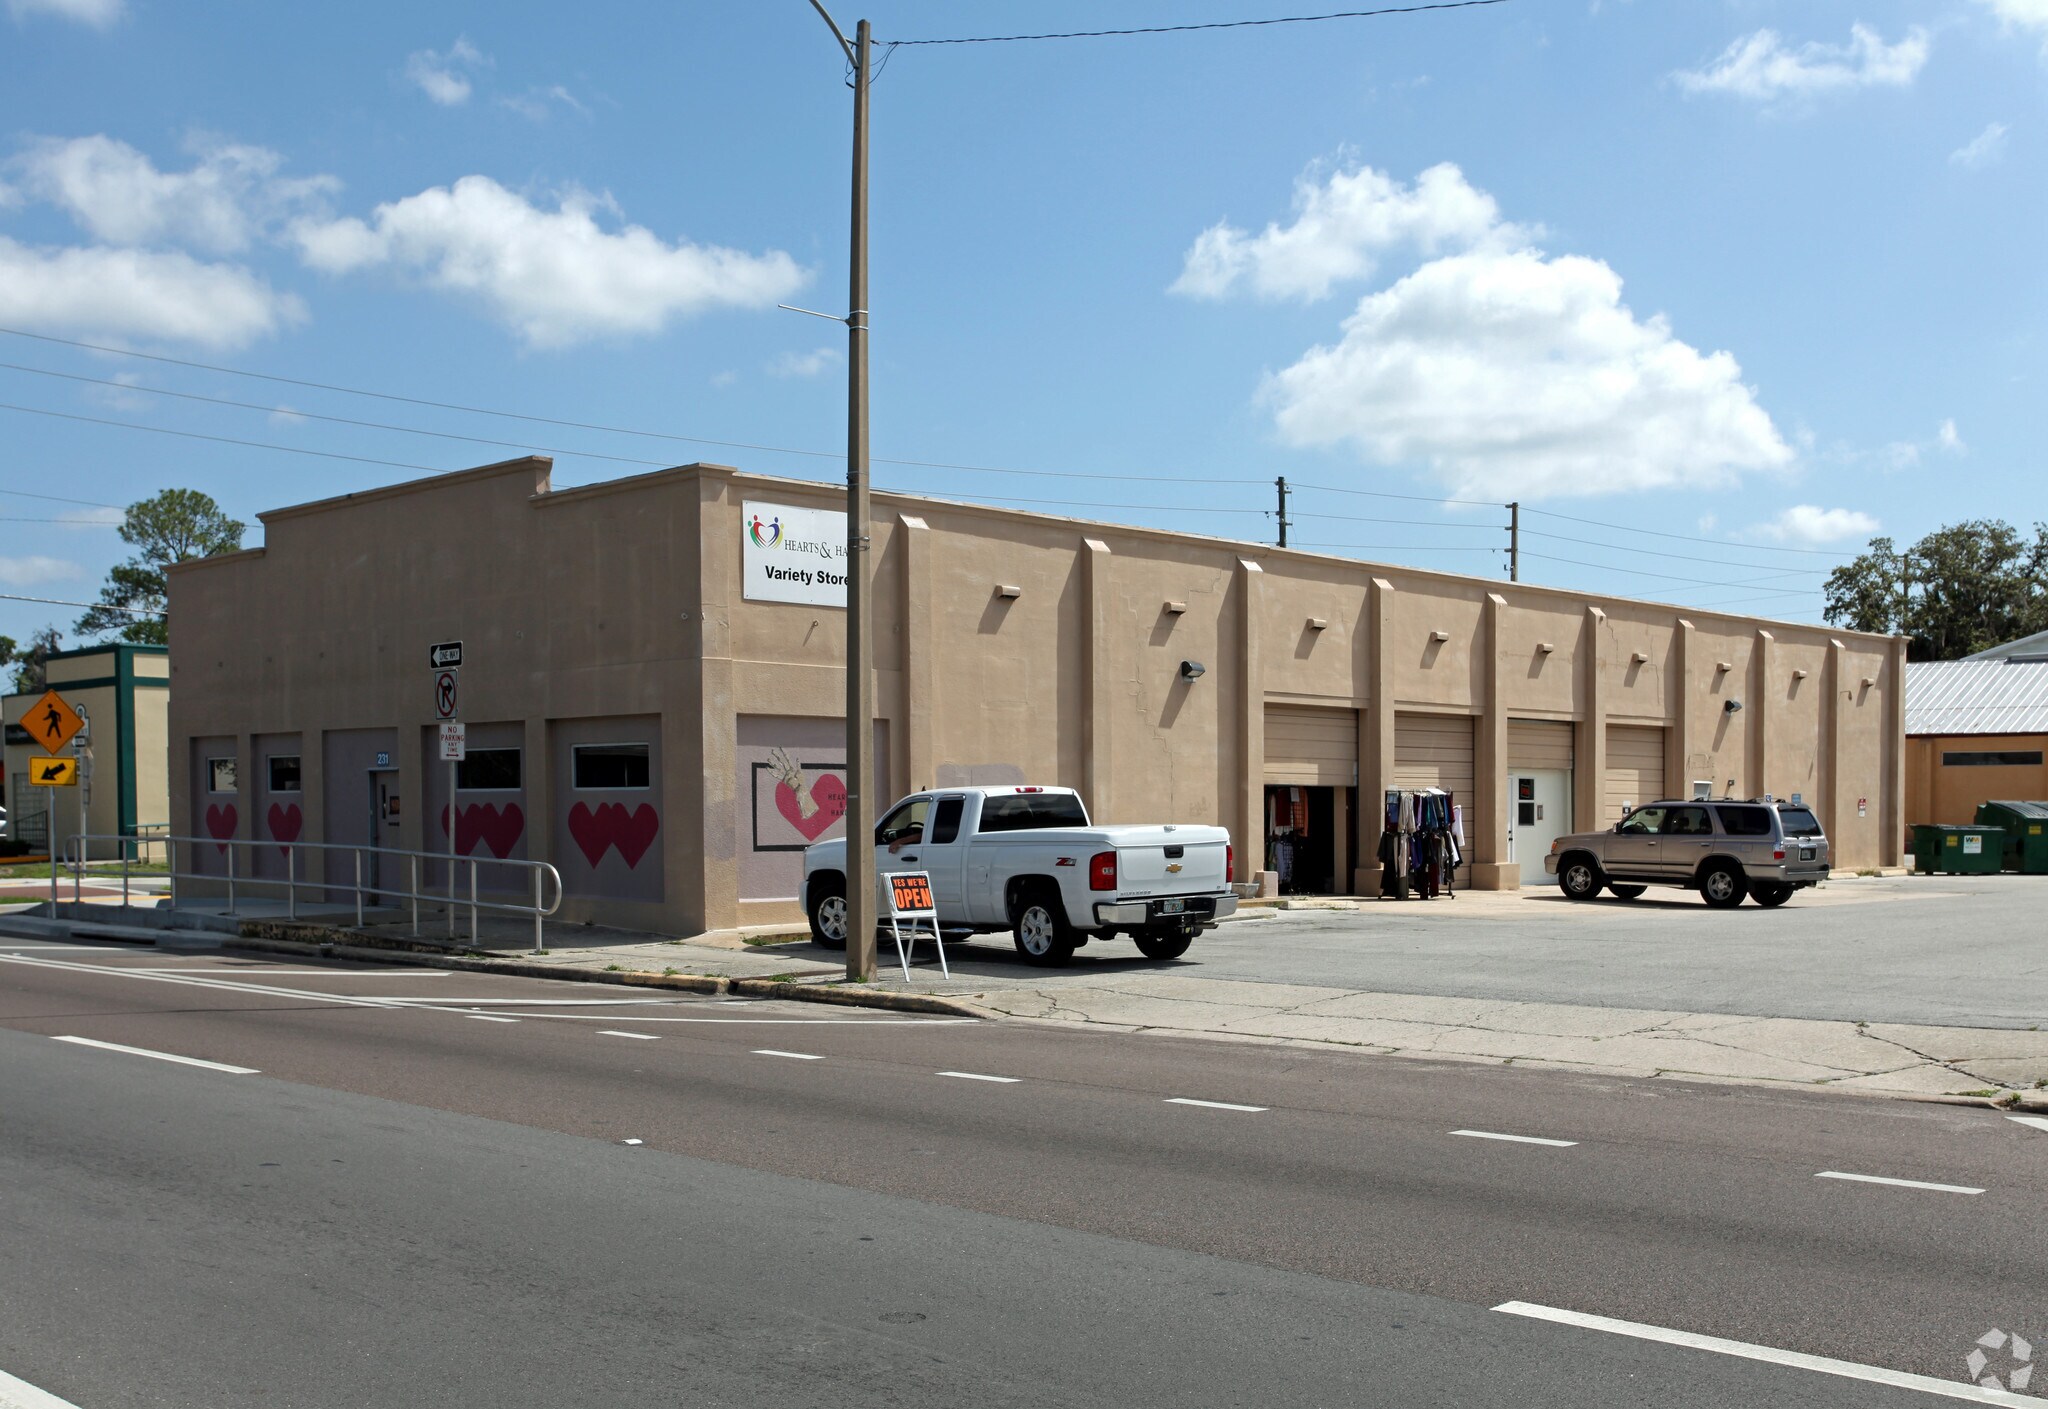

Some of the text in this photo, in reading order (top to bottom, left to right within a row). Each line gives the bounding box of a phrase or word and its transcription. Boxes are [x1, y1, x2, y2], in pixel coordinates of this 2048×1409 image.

[784, 539, 848, 559] HEARTS & HA
[765, 565, 813, 586] Variety
[439, 649, 459, 661] ONE WAY
[440, 733, 465, 742] PARKING
[377, 753, 389, 765] 231
[827, 793, 846, 801] HEAR
[893, 877, 927, 887] YES WE'RE
[894, 887, 933, 909] OPEN
